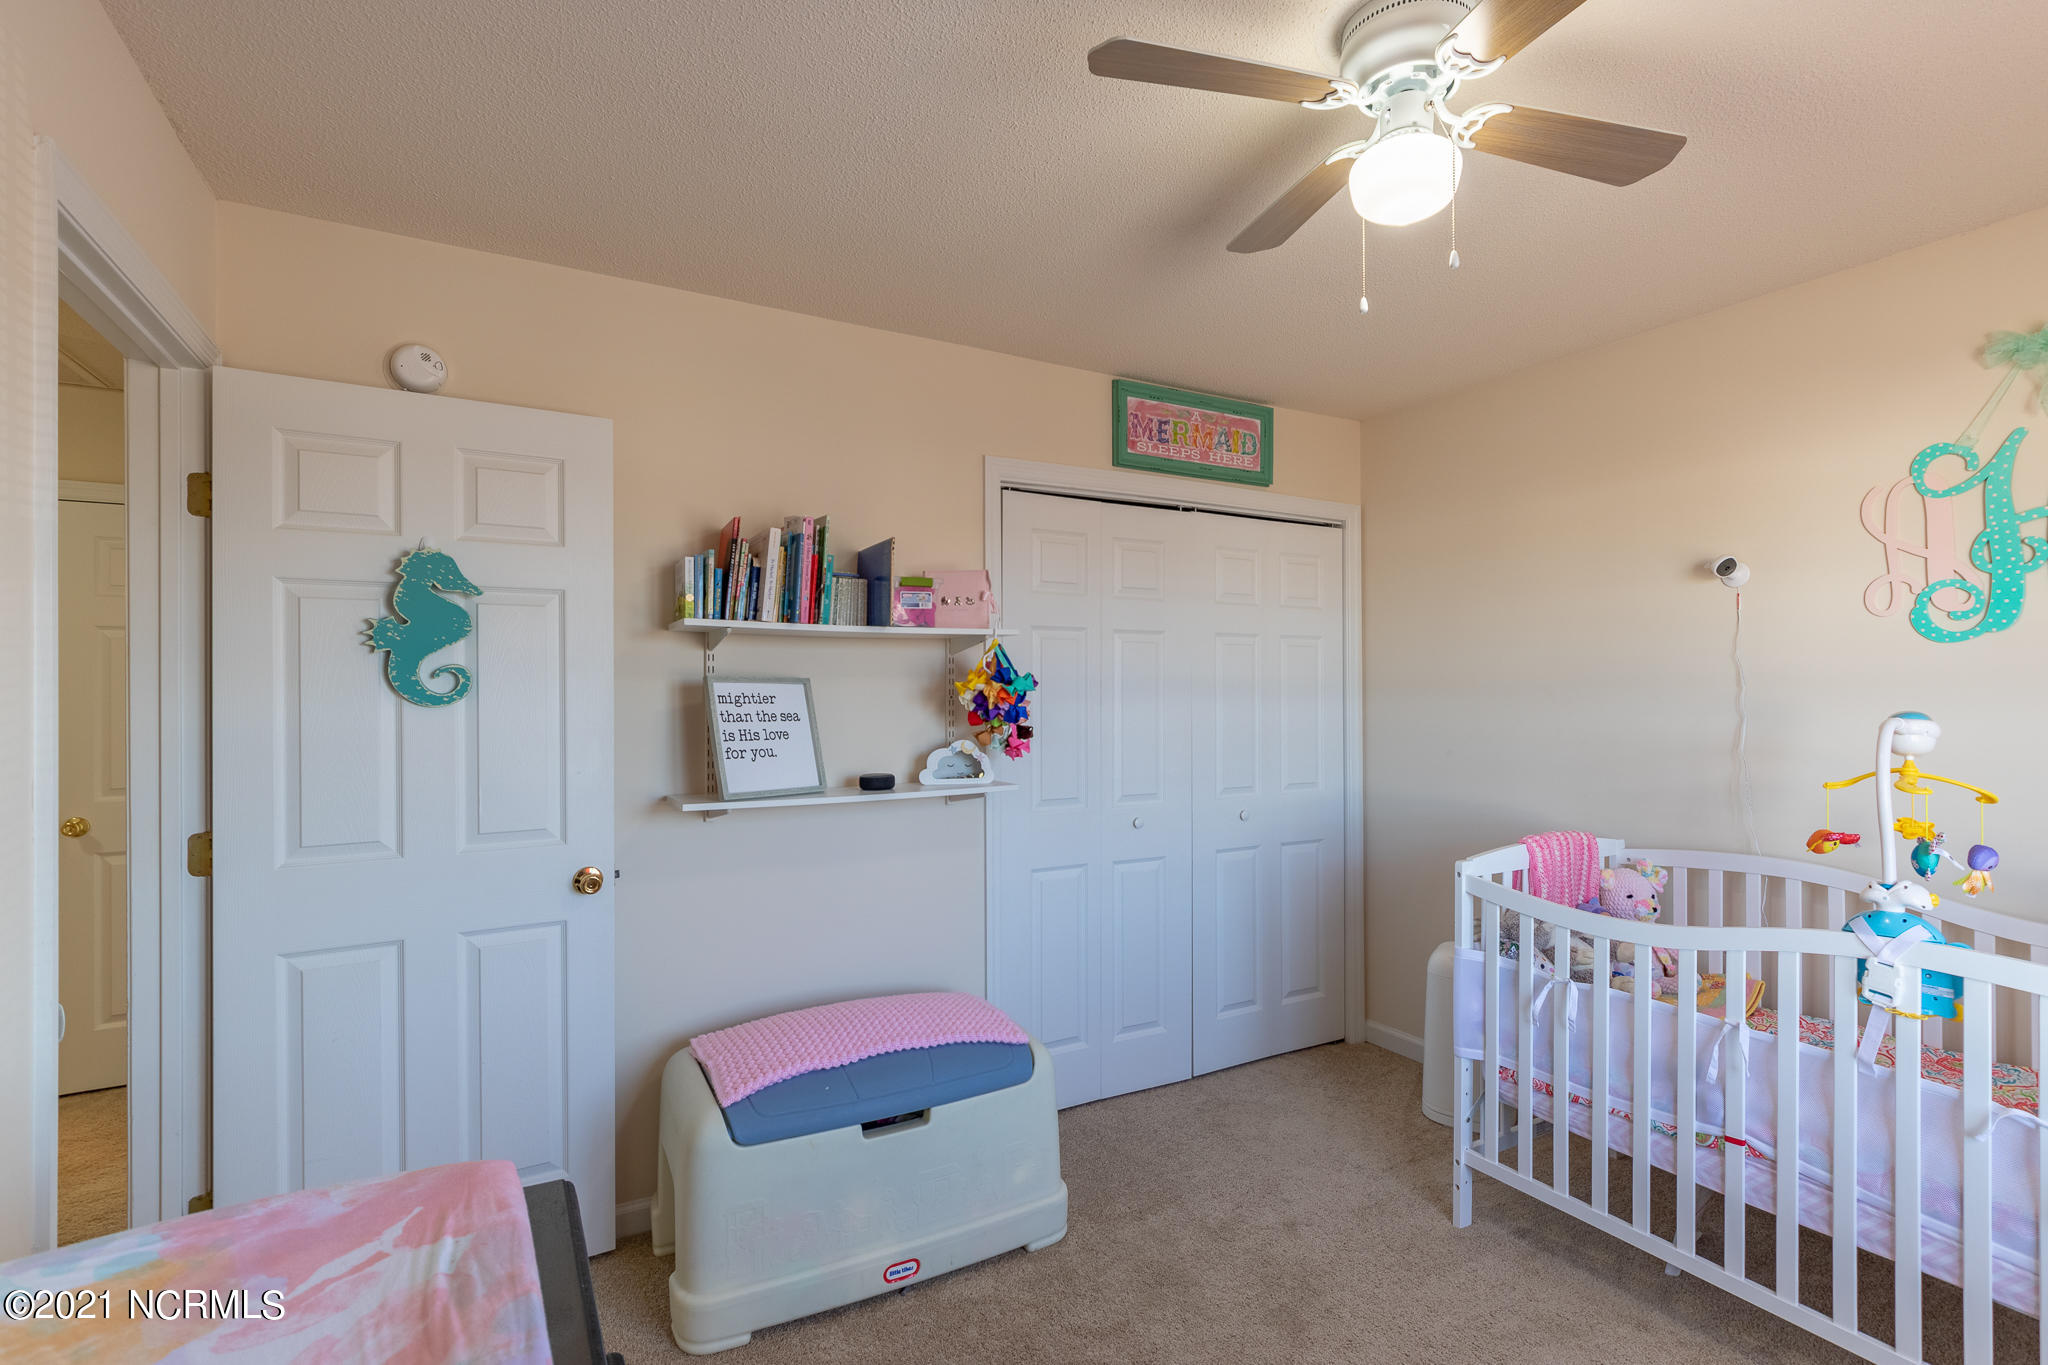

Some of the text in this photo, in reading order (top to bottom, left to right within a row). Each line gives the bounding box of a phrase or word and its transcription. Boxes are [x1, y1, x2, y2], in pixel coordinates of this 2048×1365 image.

[1191, 411, 1201, 421] A
[1129, 412, 1258, 456] MERMAID
[1137, 442, 1254, 467] SLEEPS HERE
[717, 693, 776, 707] mightier
[720, 710, 800, 723] than the sea
[722, 728, 790, 742] is His love
[725, 747, 778, 762] for you.
